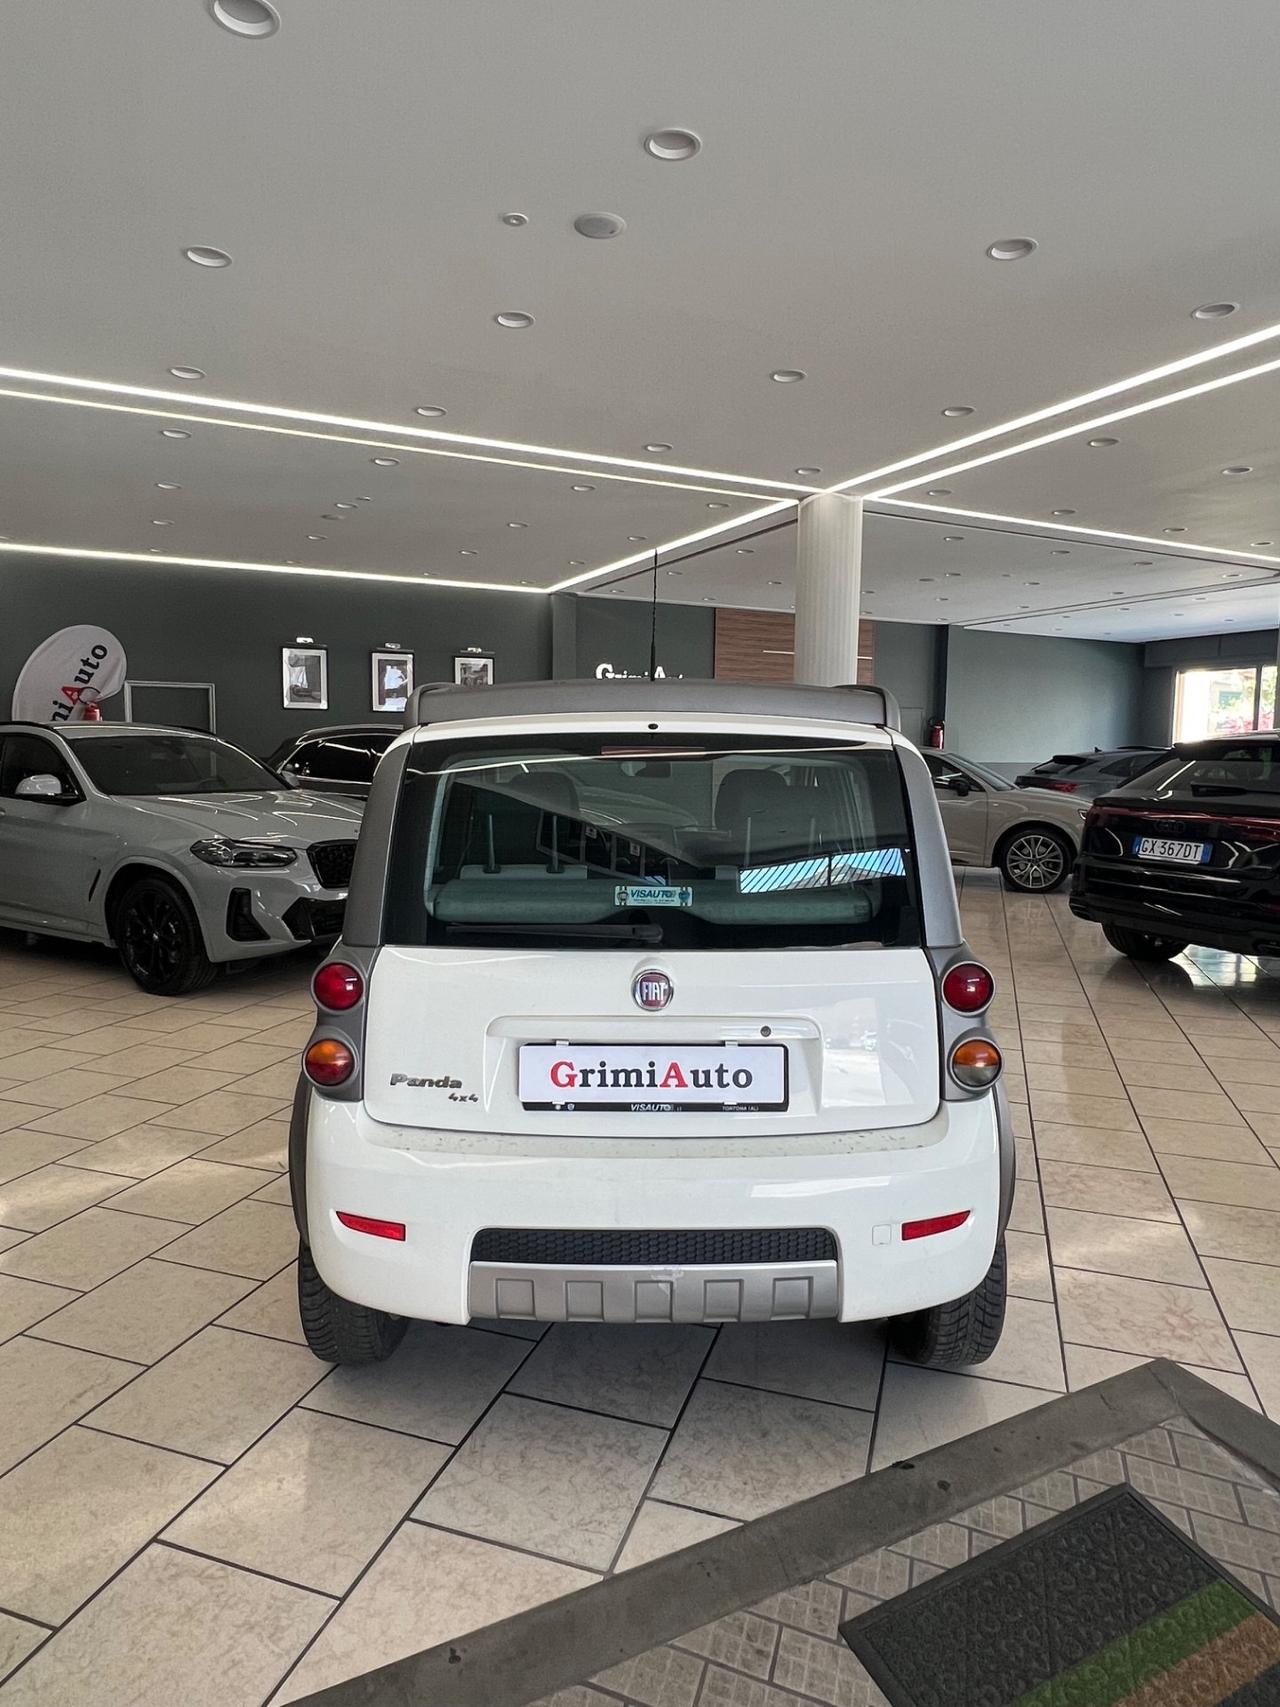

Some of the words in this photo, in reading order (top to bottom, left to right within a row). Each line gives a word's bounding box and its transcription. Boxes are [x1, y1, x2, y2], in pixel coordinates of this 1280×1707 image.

[1160, 842, 1201, 860] 367DT
[642, 981, 667, 1001] FIAT
[389, 1073, 463, 1088] Panda
[550, 1061, 754, 1089] GrimiAuto
[448, 1092, 479, 1103] 4x4
[630, 1103, 672, 1111] VISAUTO
